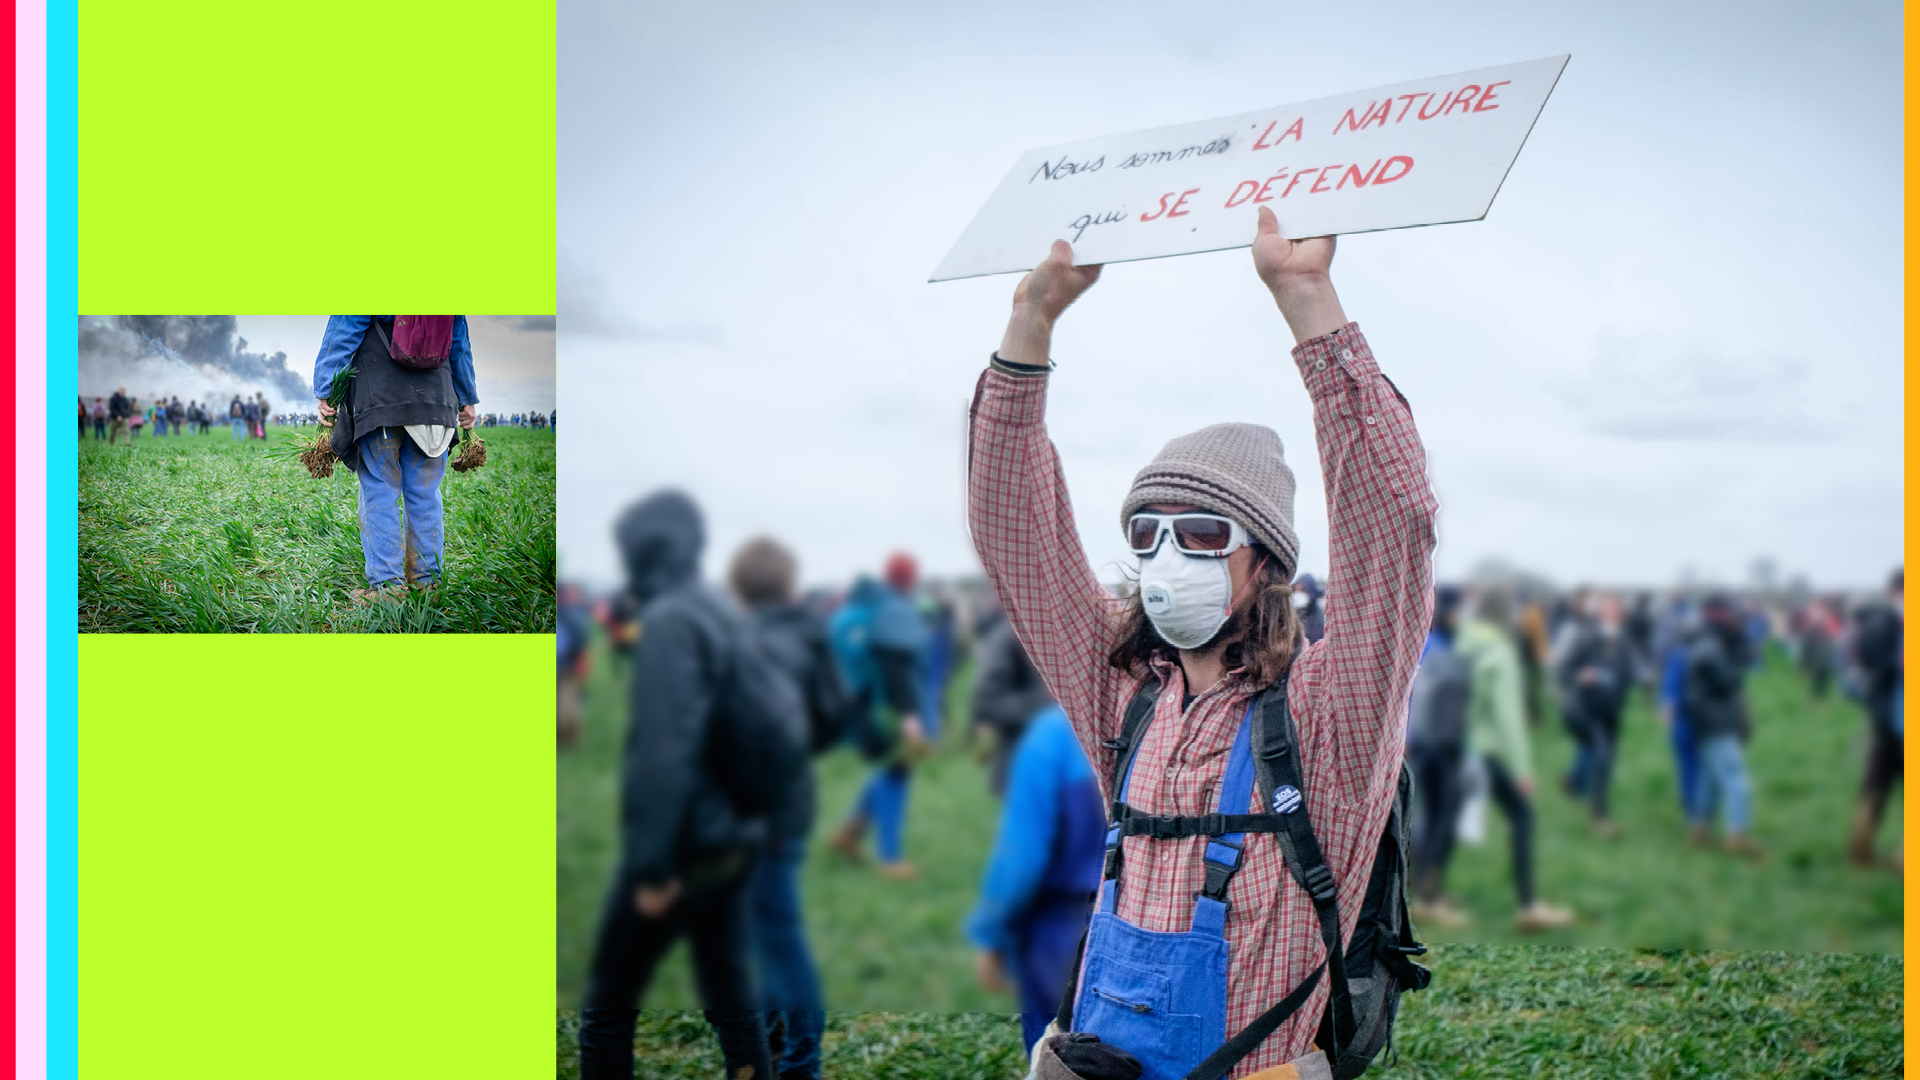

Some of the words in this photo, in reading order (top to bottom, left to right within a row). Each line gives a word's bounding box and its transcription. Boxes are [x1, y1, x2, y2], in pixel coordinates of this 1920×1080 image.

[1029, 155, 1106, 184] Nous
[1116, 138, 1231, 169] sommes
[1252, 117, 1304, 151] LA
[1332, 80, 1512, 135] NATURE
[1067, 204, 1128, 244] qui
[1140, 189, 1200, 222] SE
[1224, 155, 1415, 209] DÉFEND
